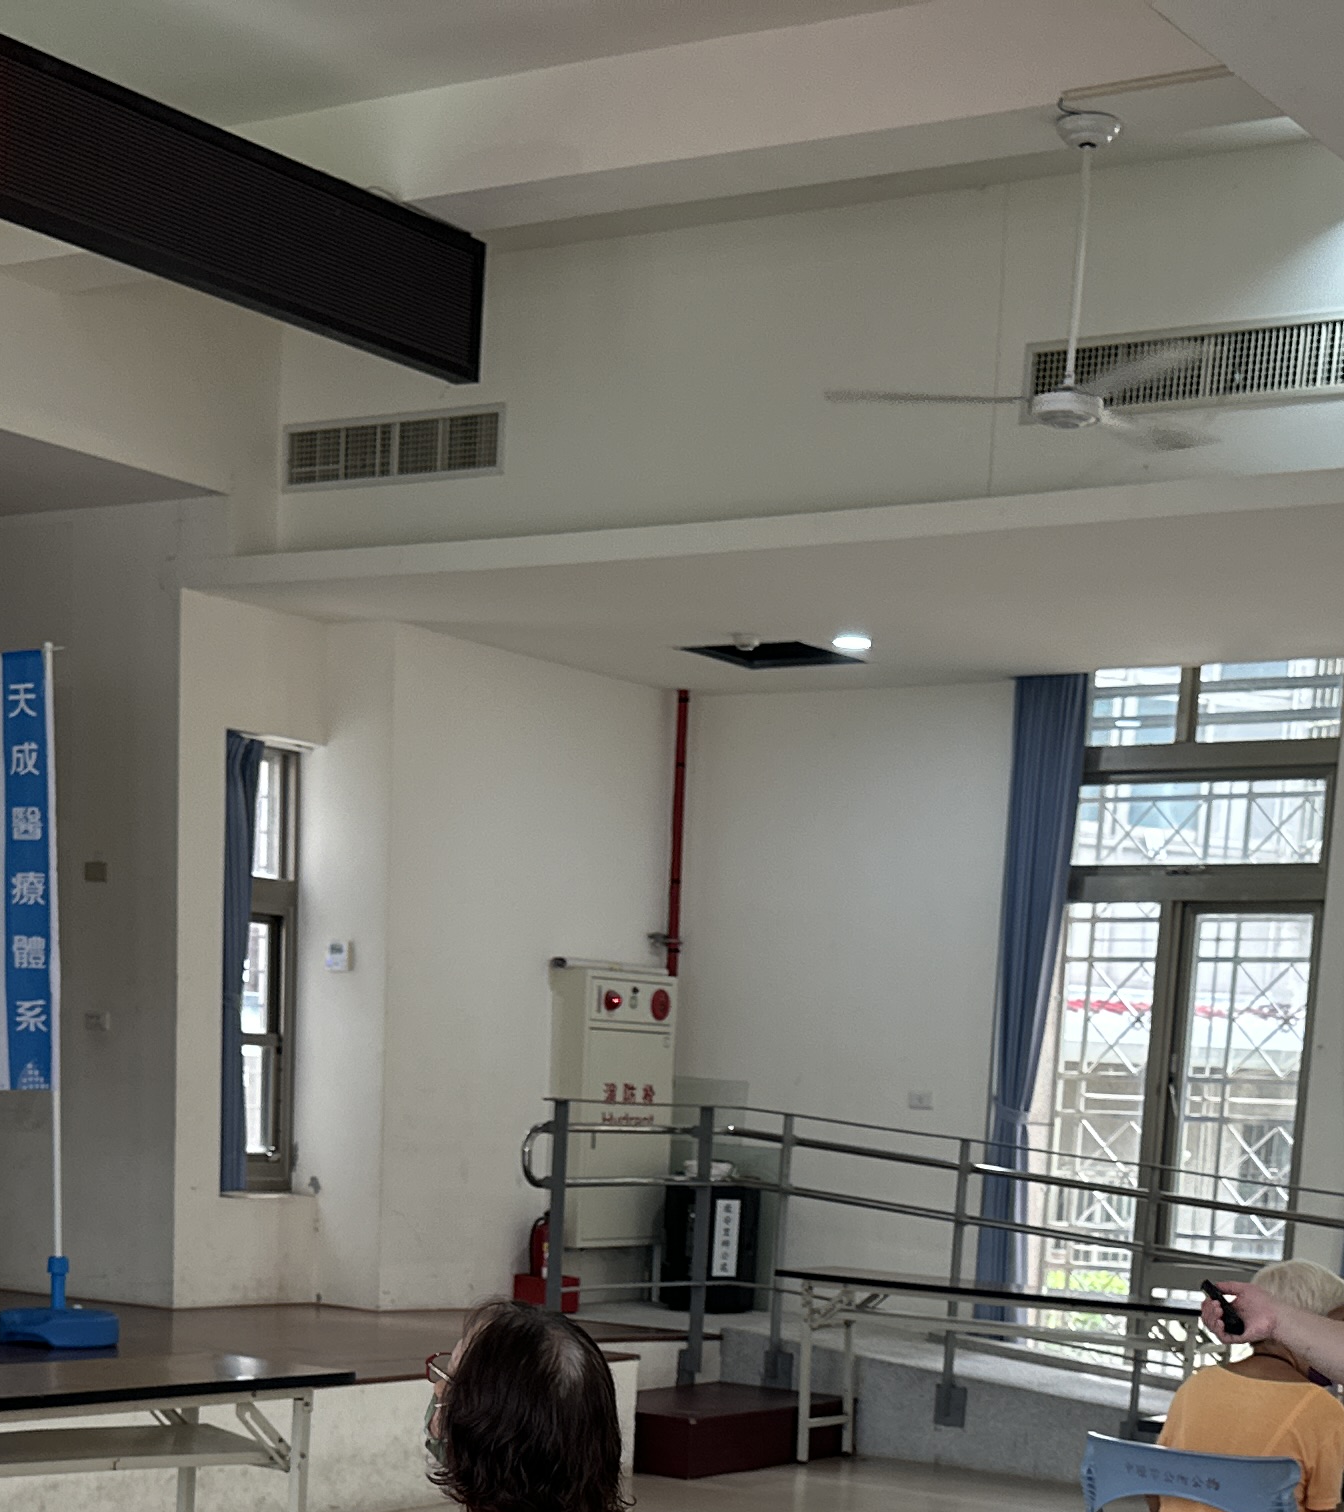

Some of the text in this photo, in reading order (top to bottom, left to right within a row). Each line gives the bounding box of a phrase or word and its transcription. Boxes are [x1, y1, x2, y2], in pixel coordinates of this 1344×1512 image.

[7, 682, 48, 1033] 天成醫療體系
